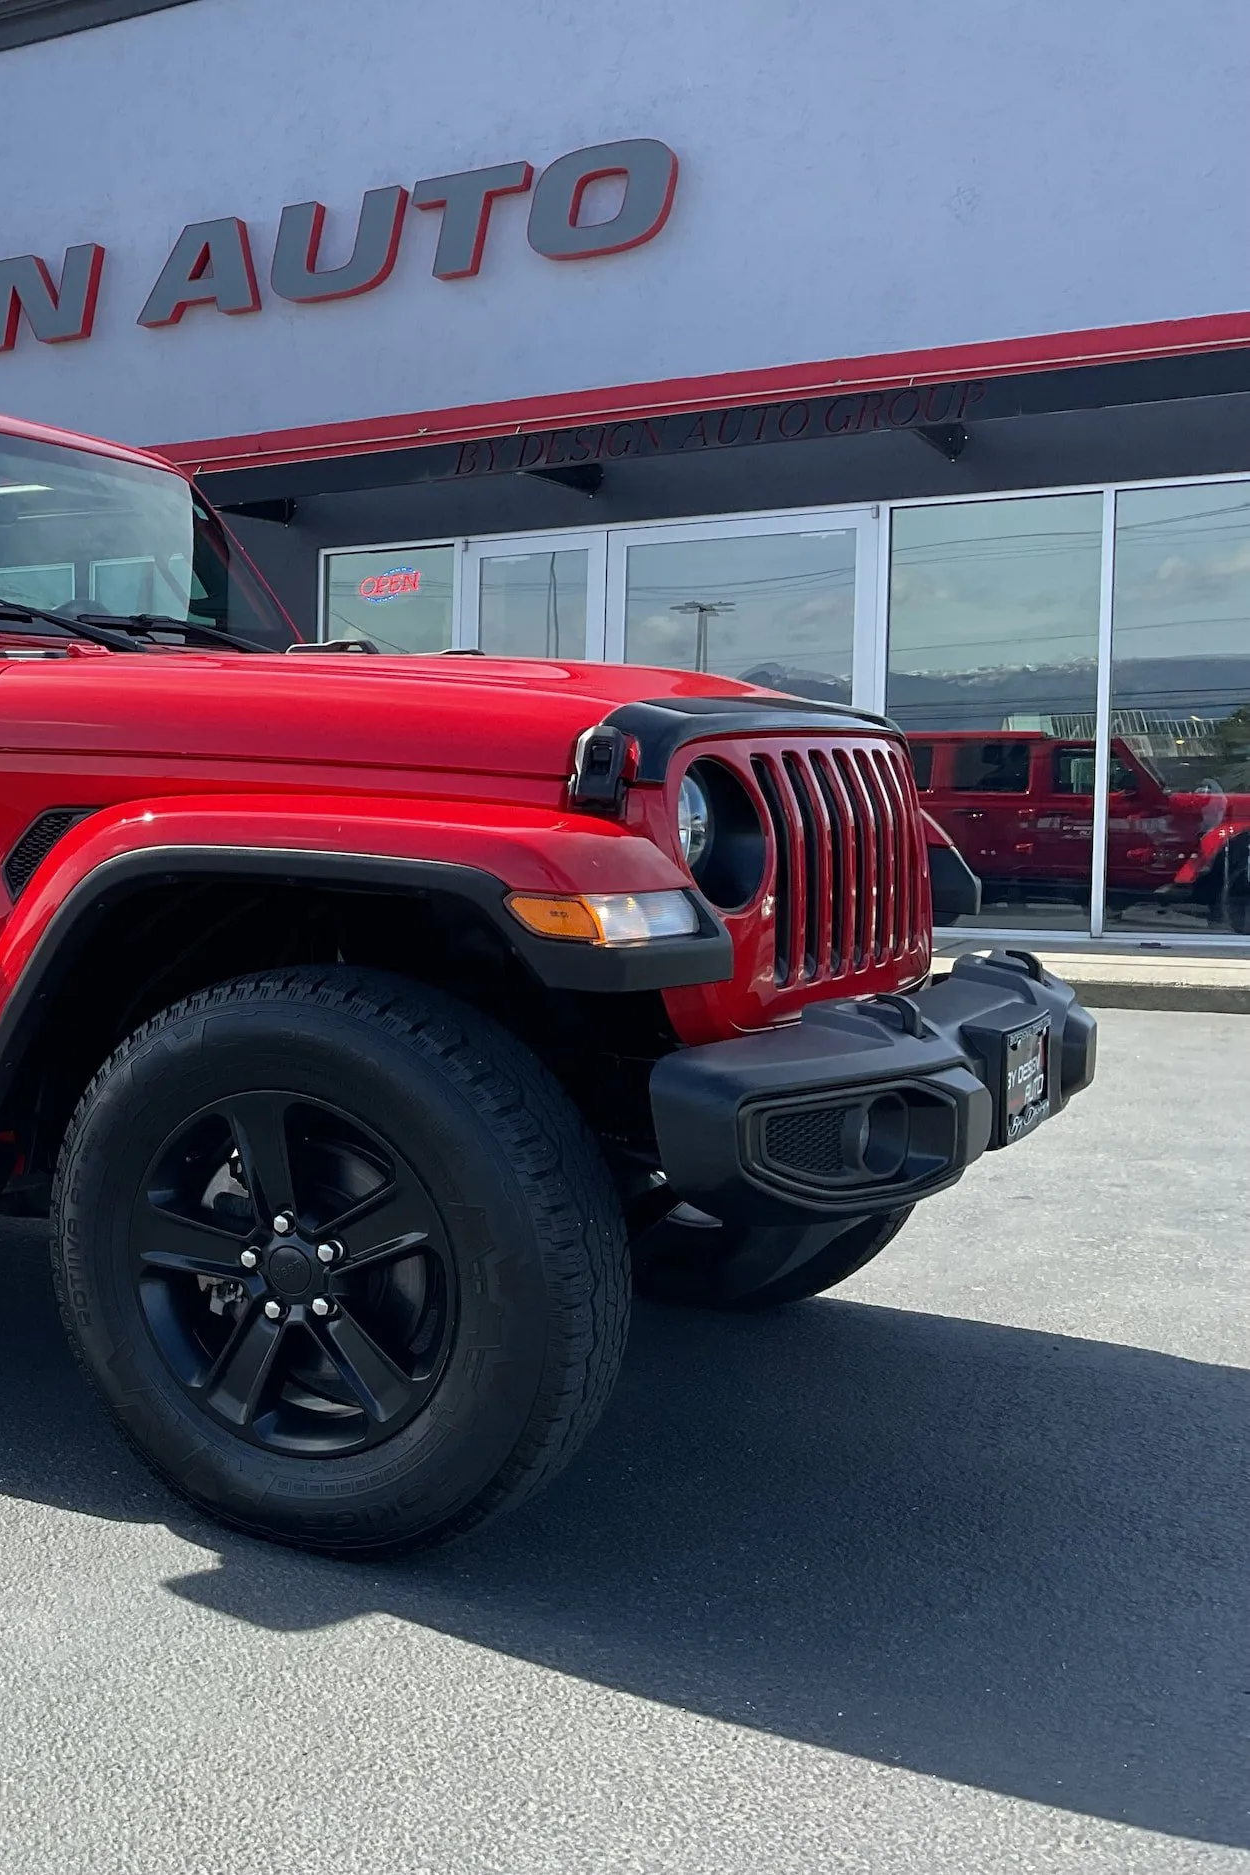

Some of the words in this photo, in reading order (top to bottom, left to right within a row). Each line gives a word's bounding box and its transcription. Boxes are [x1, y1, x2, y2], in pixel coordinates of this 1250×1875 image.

[137, 138, 678, 327] AUTO
[454, 438, 508, 475] BY
[517, 418, 669, 468] DESIGN
[680, 401, 810, 448] AUTO
[824, 382, 986, 433] GROUP
[359, 571, 421, 597] OPEN
